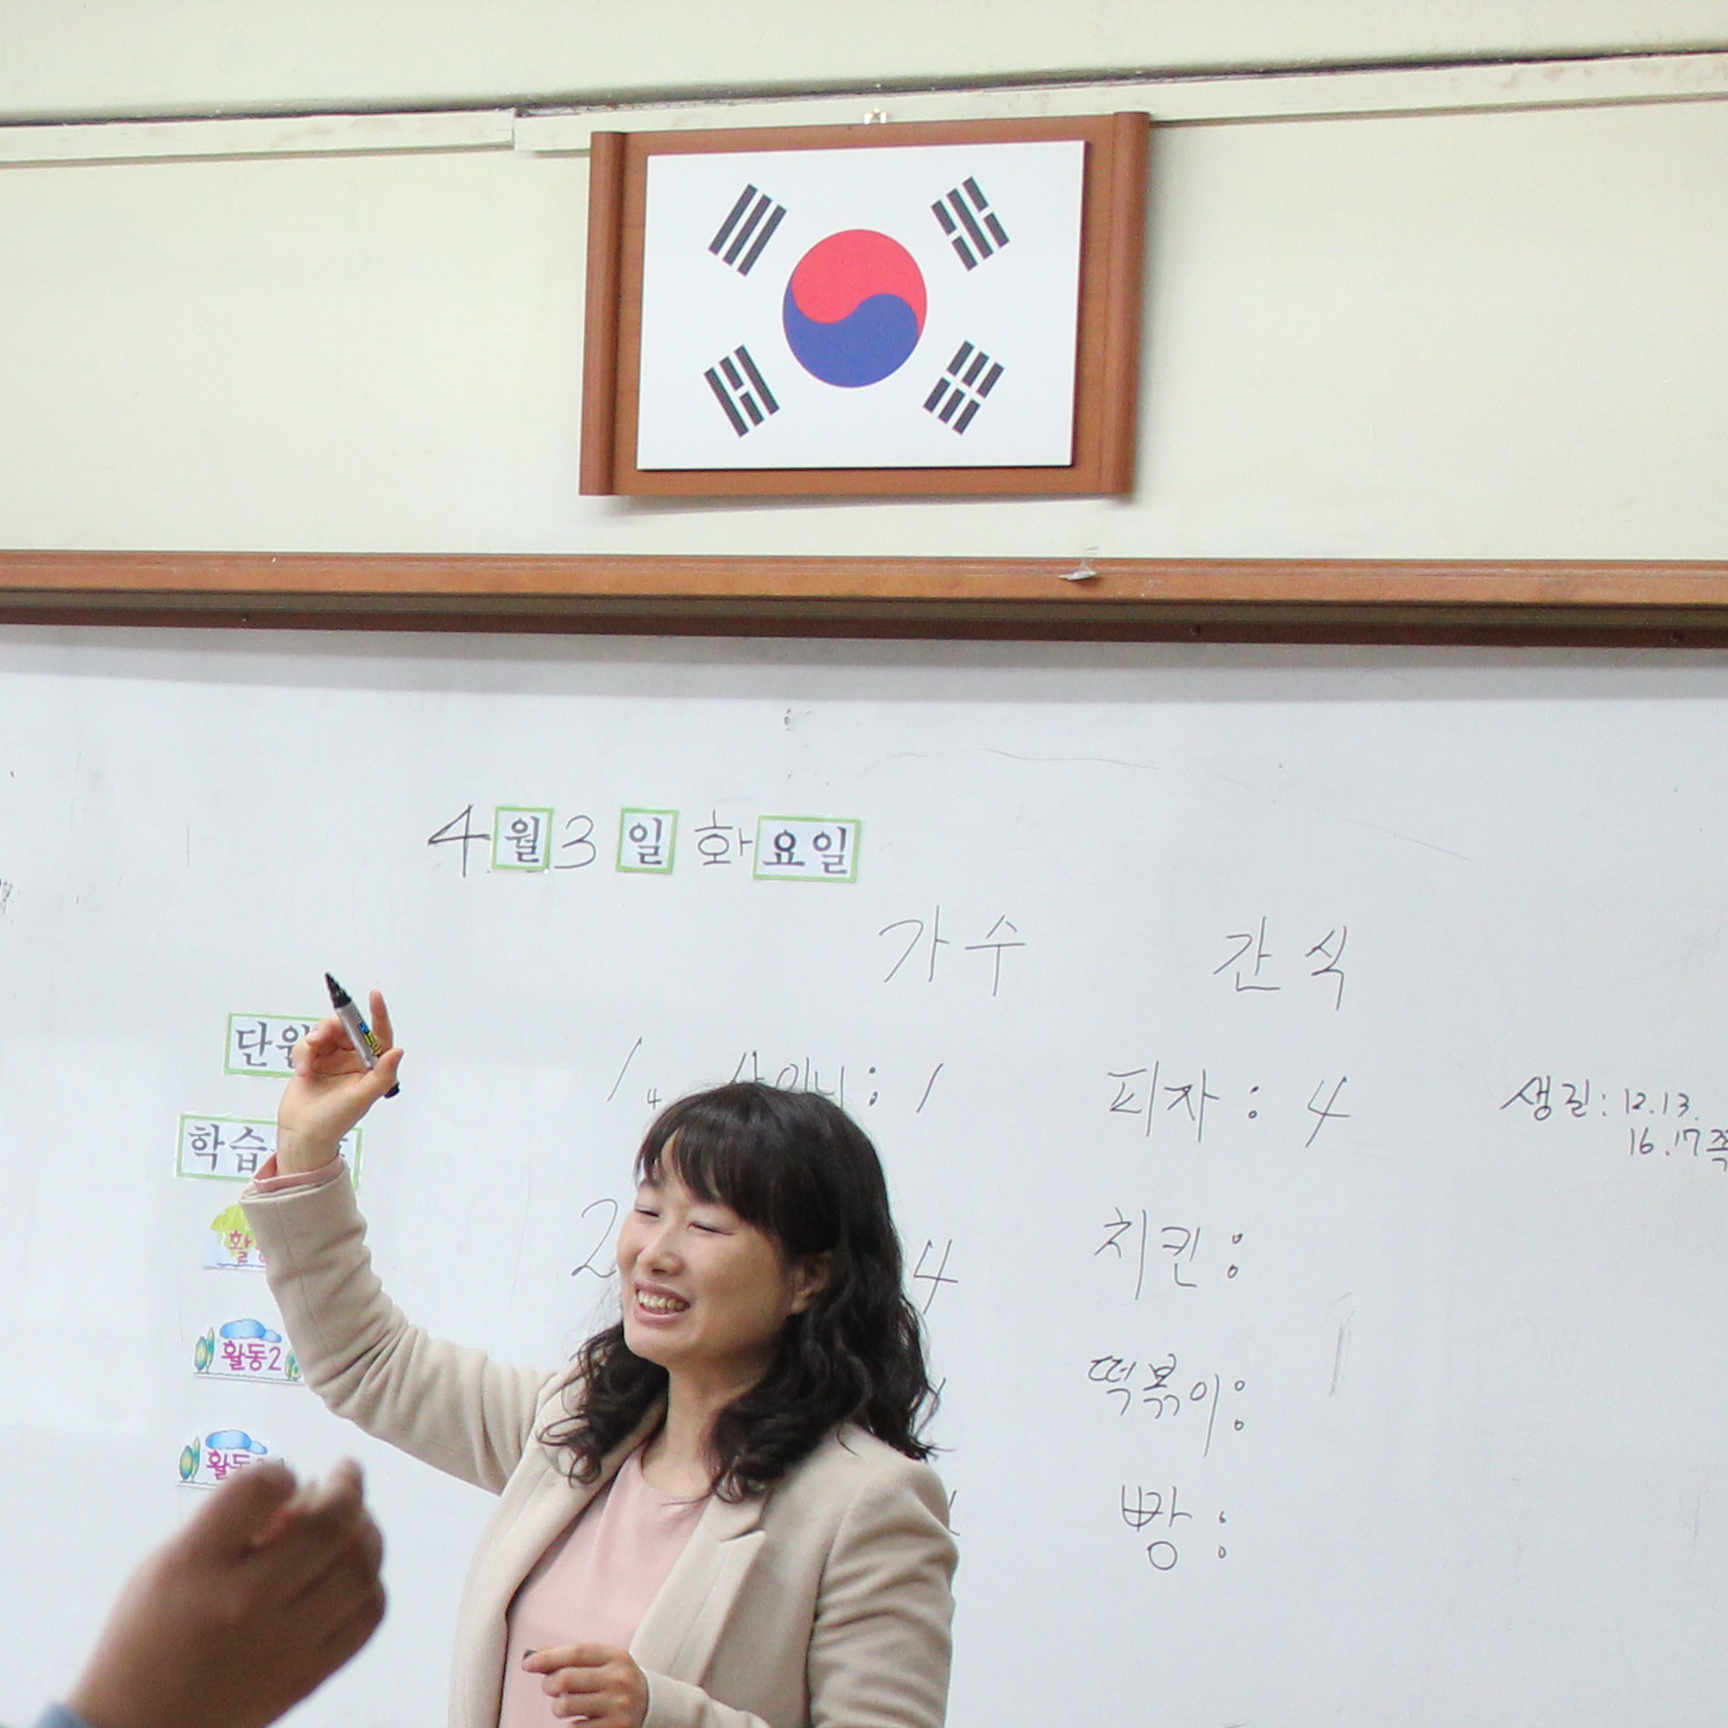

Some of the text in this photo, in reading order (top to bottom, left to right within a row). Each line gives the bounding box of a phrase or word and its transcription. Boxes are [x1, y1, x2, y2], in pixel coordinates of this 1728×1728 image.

[879, 905, 1026, 997] 가수
[1213, 916, 1347, 1010] 간식
[220, 1340, 282, 1372] 활동2
